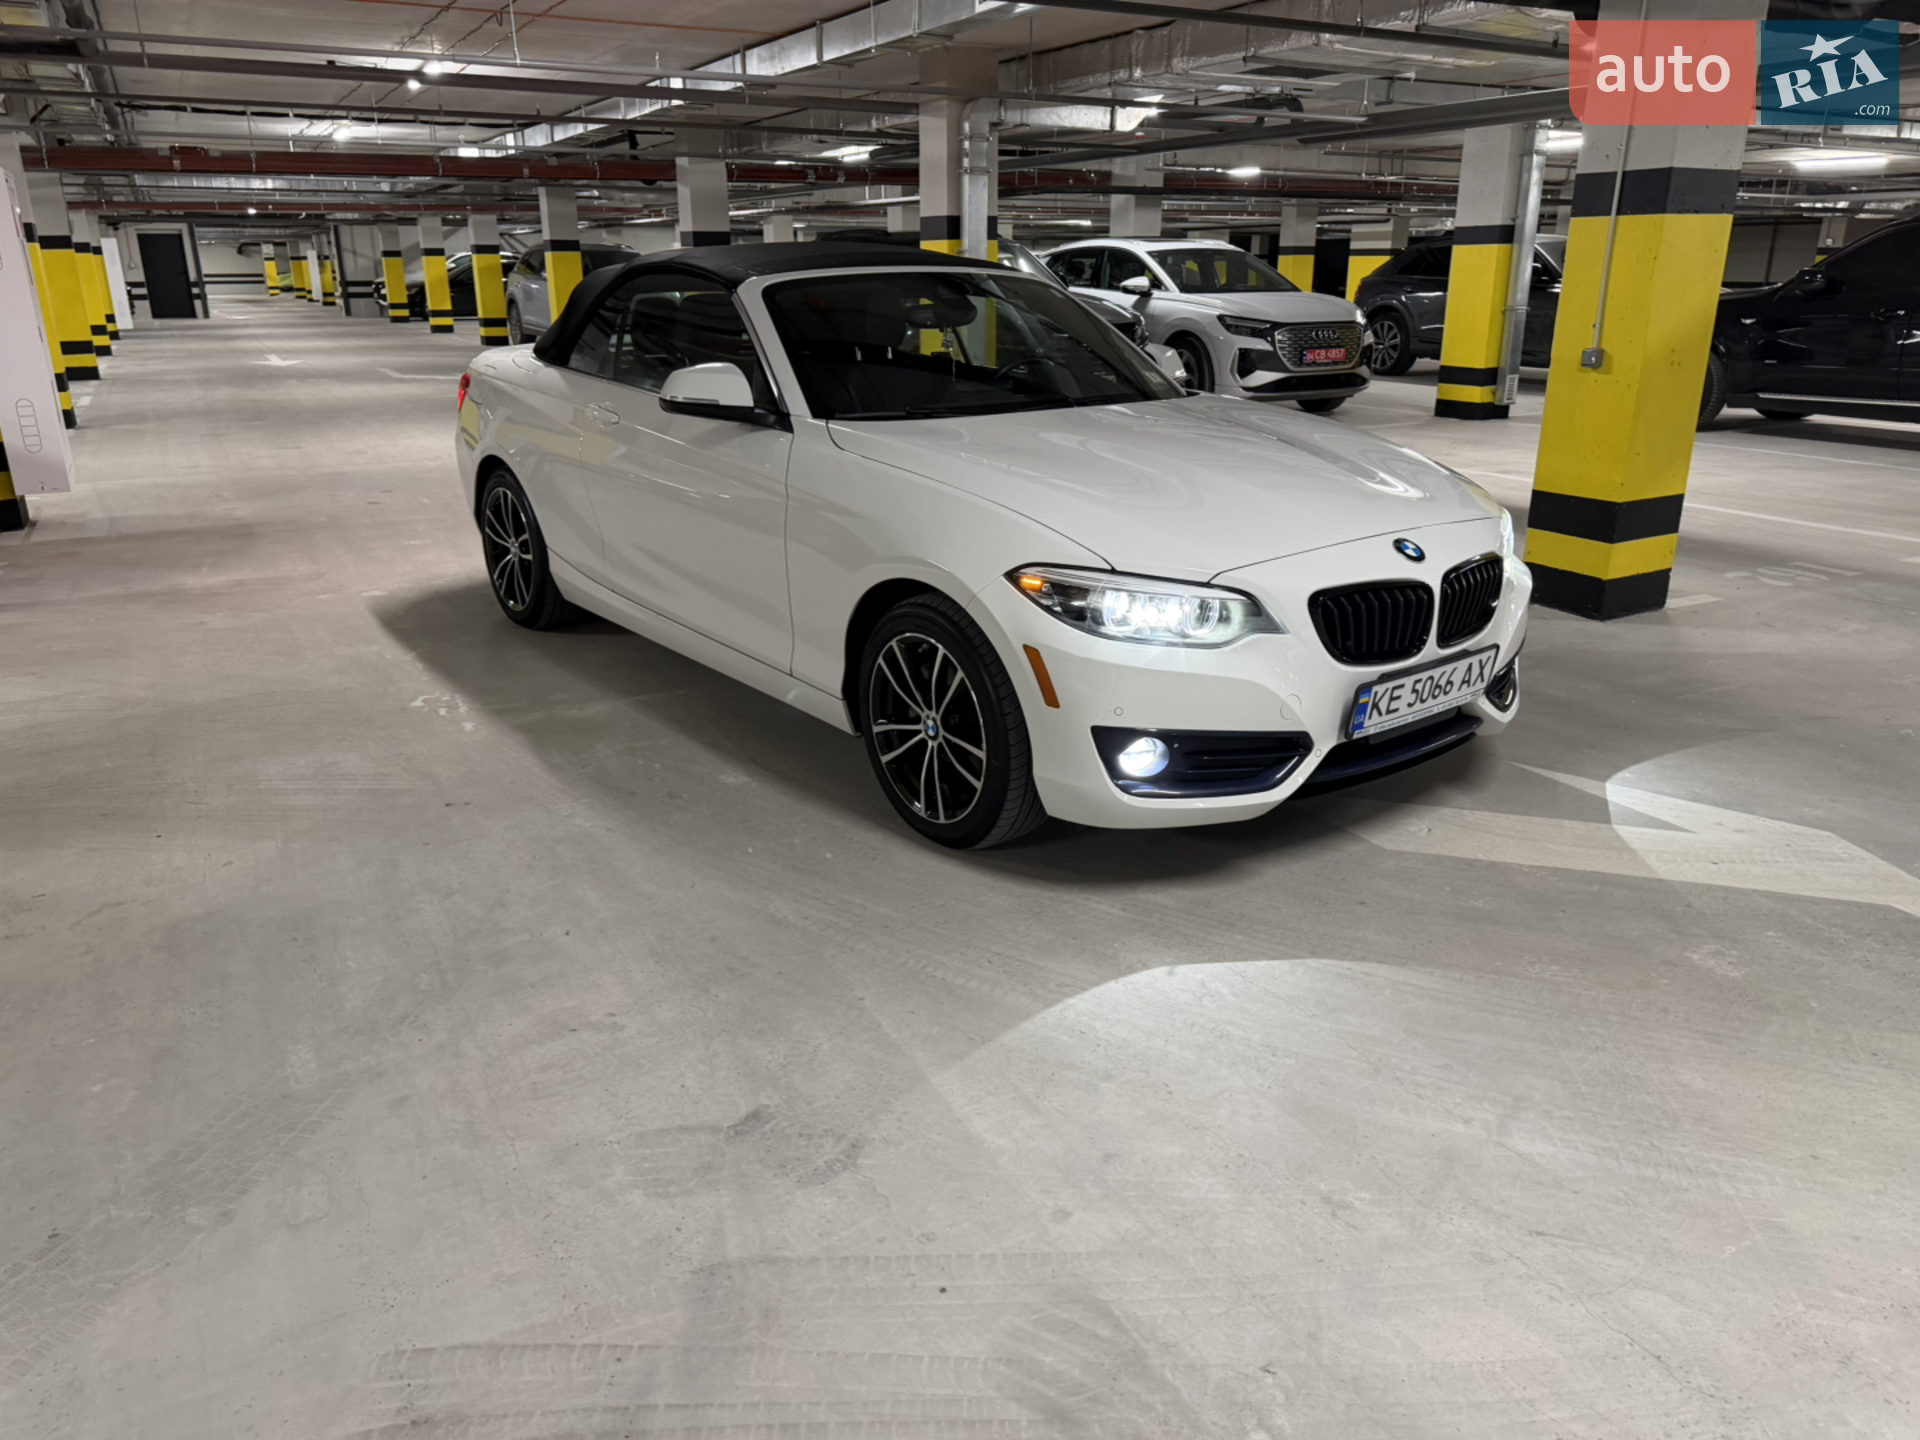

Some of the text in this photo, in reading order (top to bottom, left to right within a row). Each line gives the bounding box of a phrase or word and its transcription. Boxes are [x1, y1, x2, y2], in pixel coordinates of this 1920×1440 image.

[1368, 683, 1406, 720] KE
[1407, 667, 1458, 708] 5066
[1458, 655, 1492, 691] AX
[1354, 713, 1365, 725] UA
